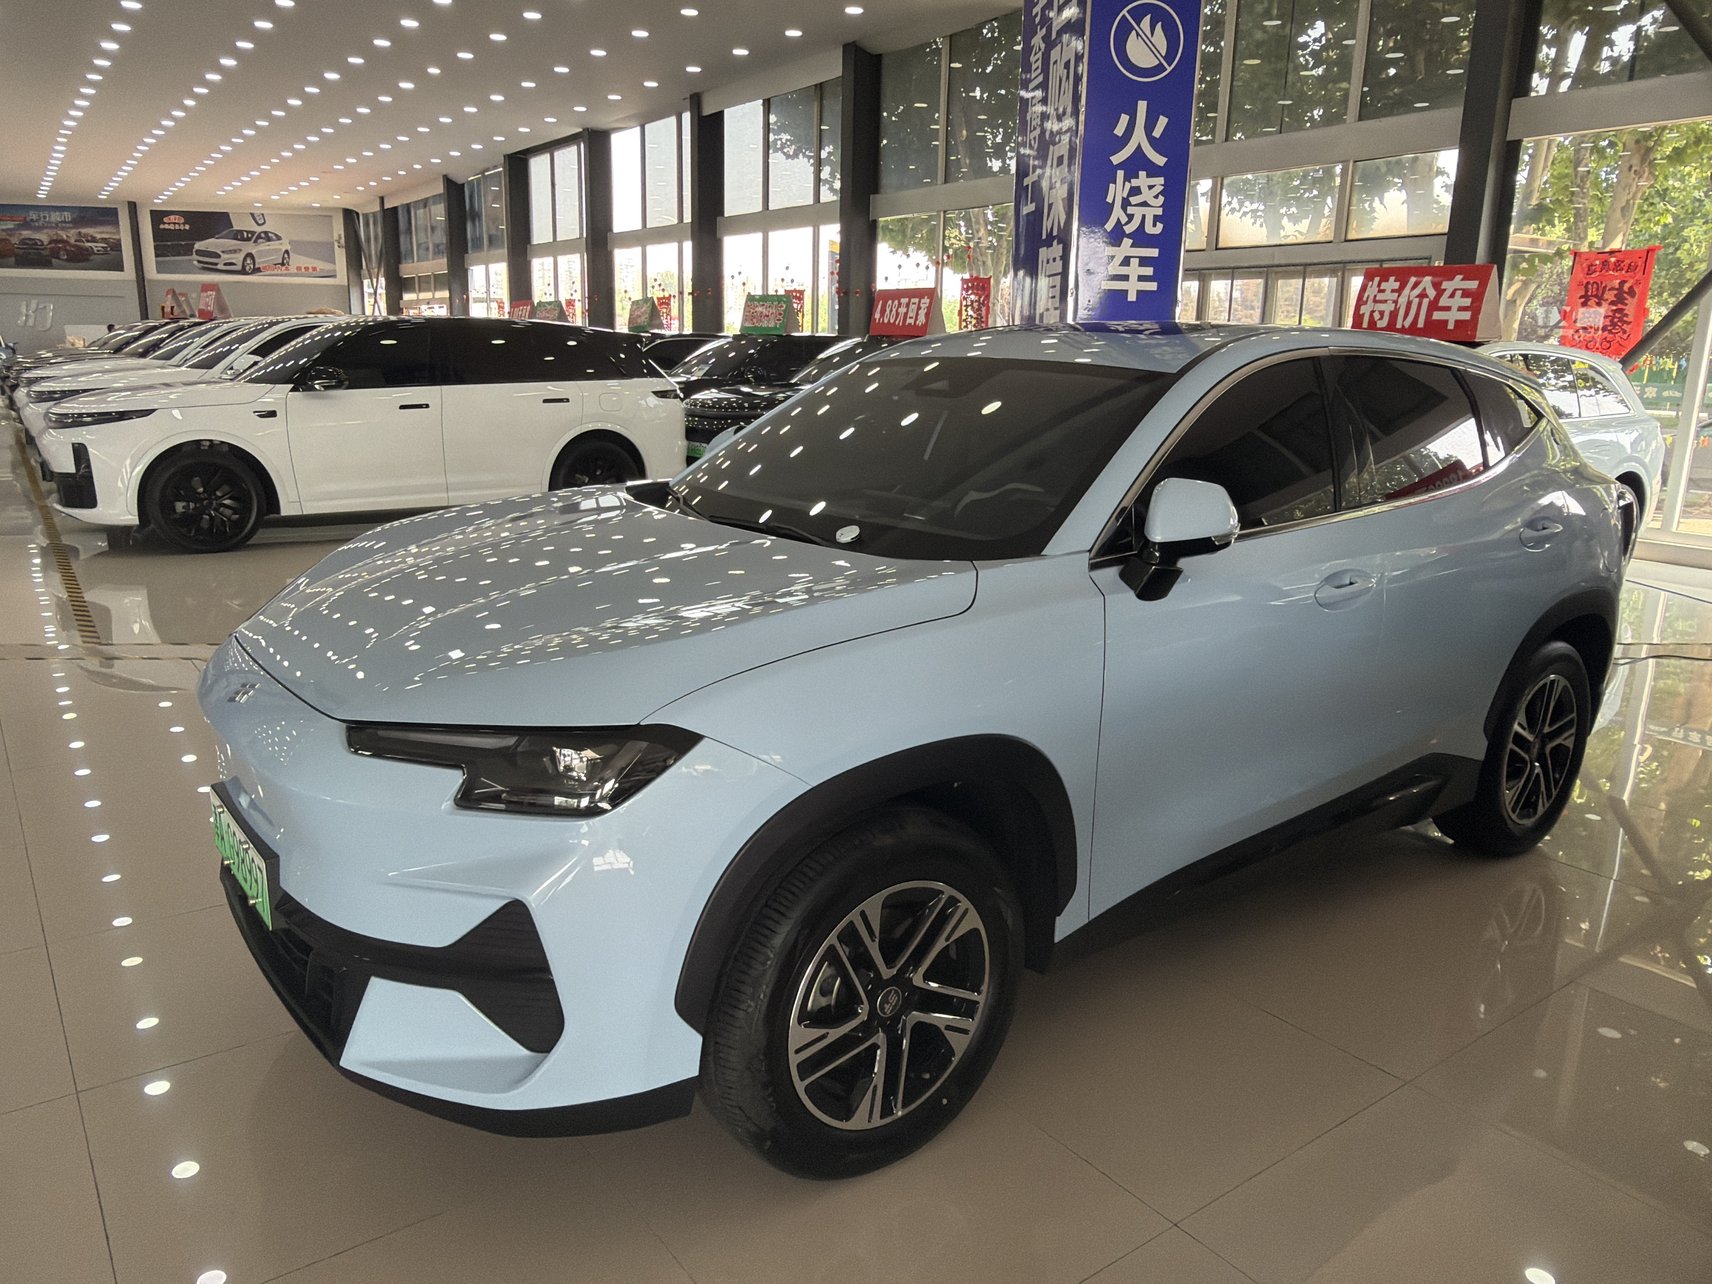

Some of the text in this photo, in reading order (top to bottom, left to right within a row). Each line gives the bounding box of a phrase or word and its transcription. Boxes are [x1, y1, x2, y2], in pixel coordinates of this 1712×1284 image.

[1101, 100, 1169, 302] 火烧车
[874, 296, 930, 327] 4.88开回家
[1360, 274, 1480, 330] 特价车
